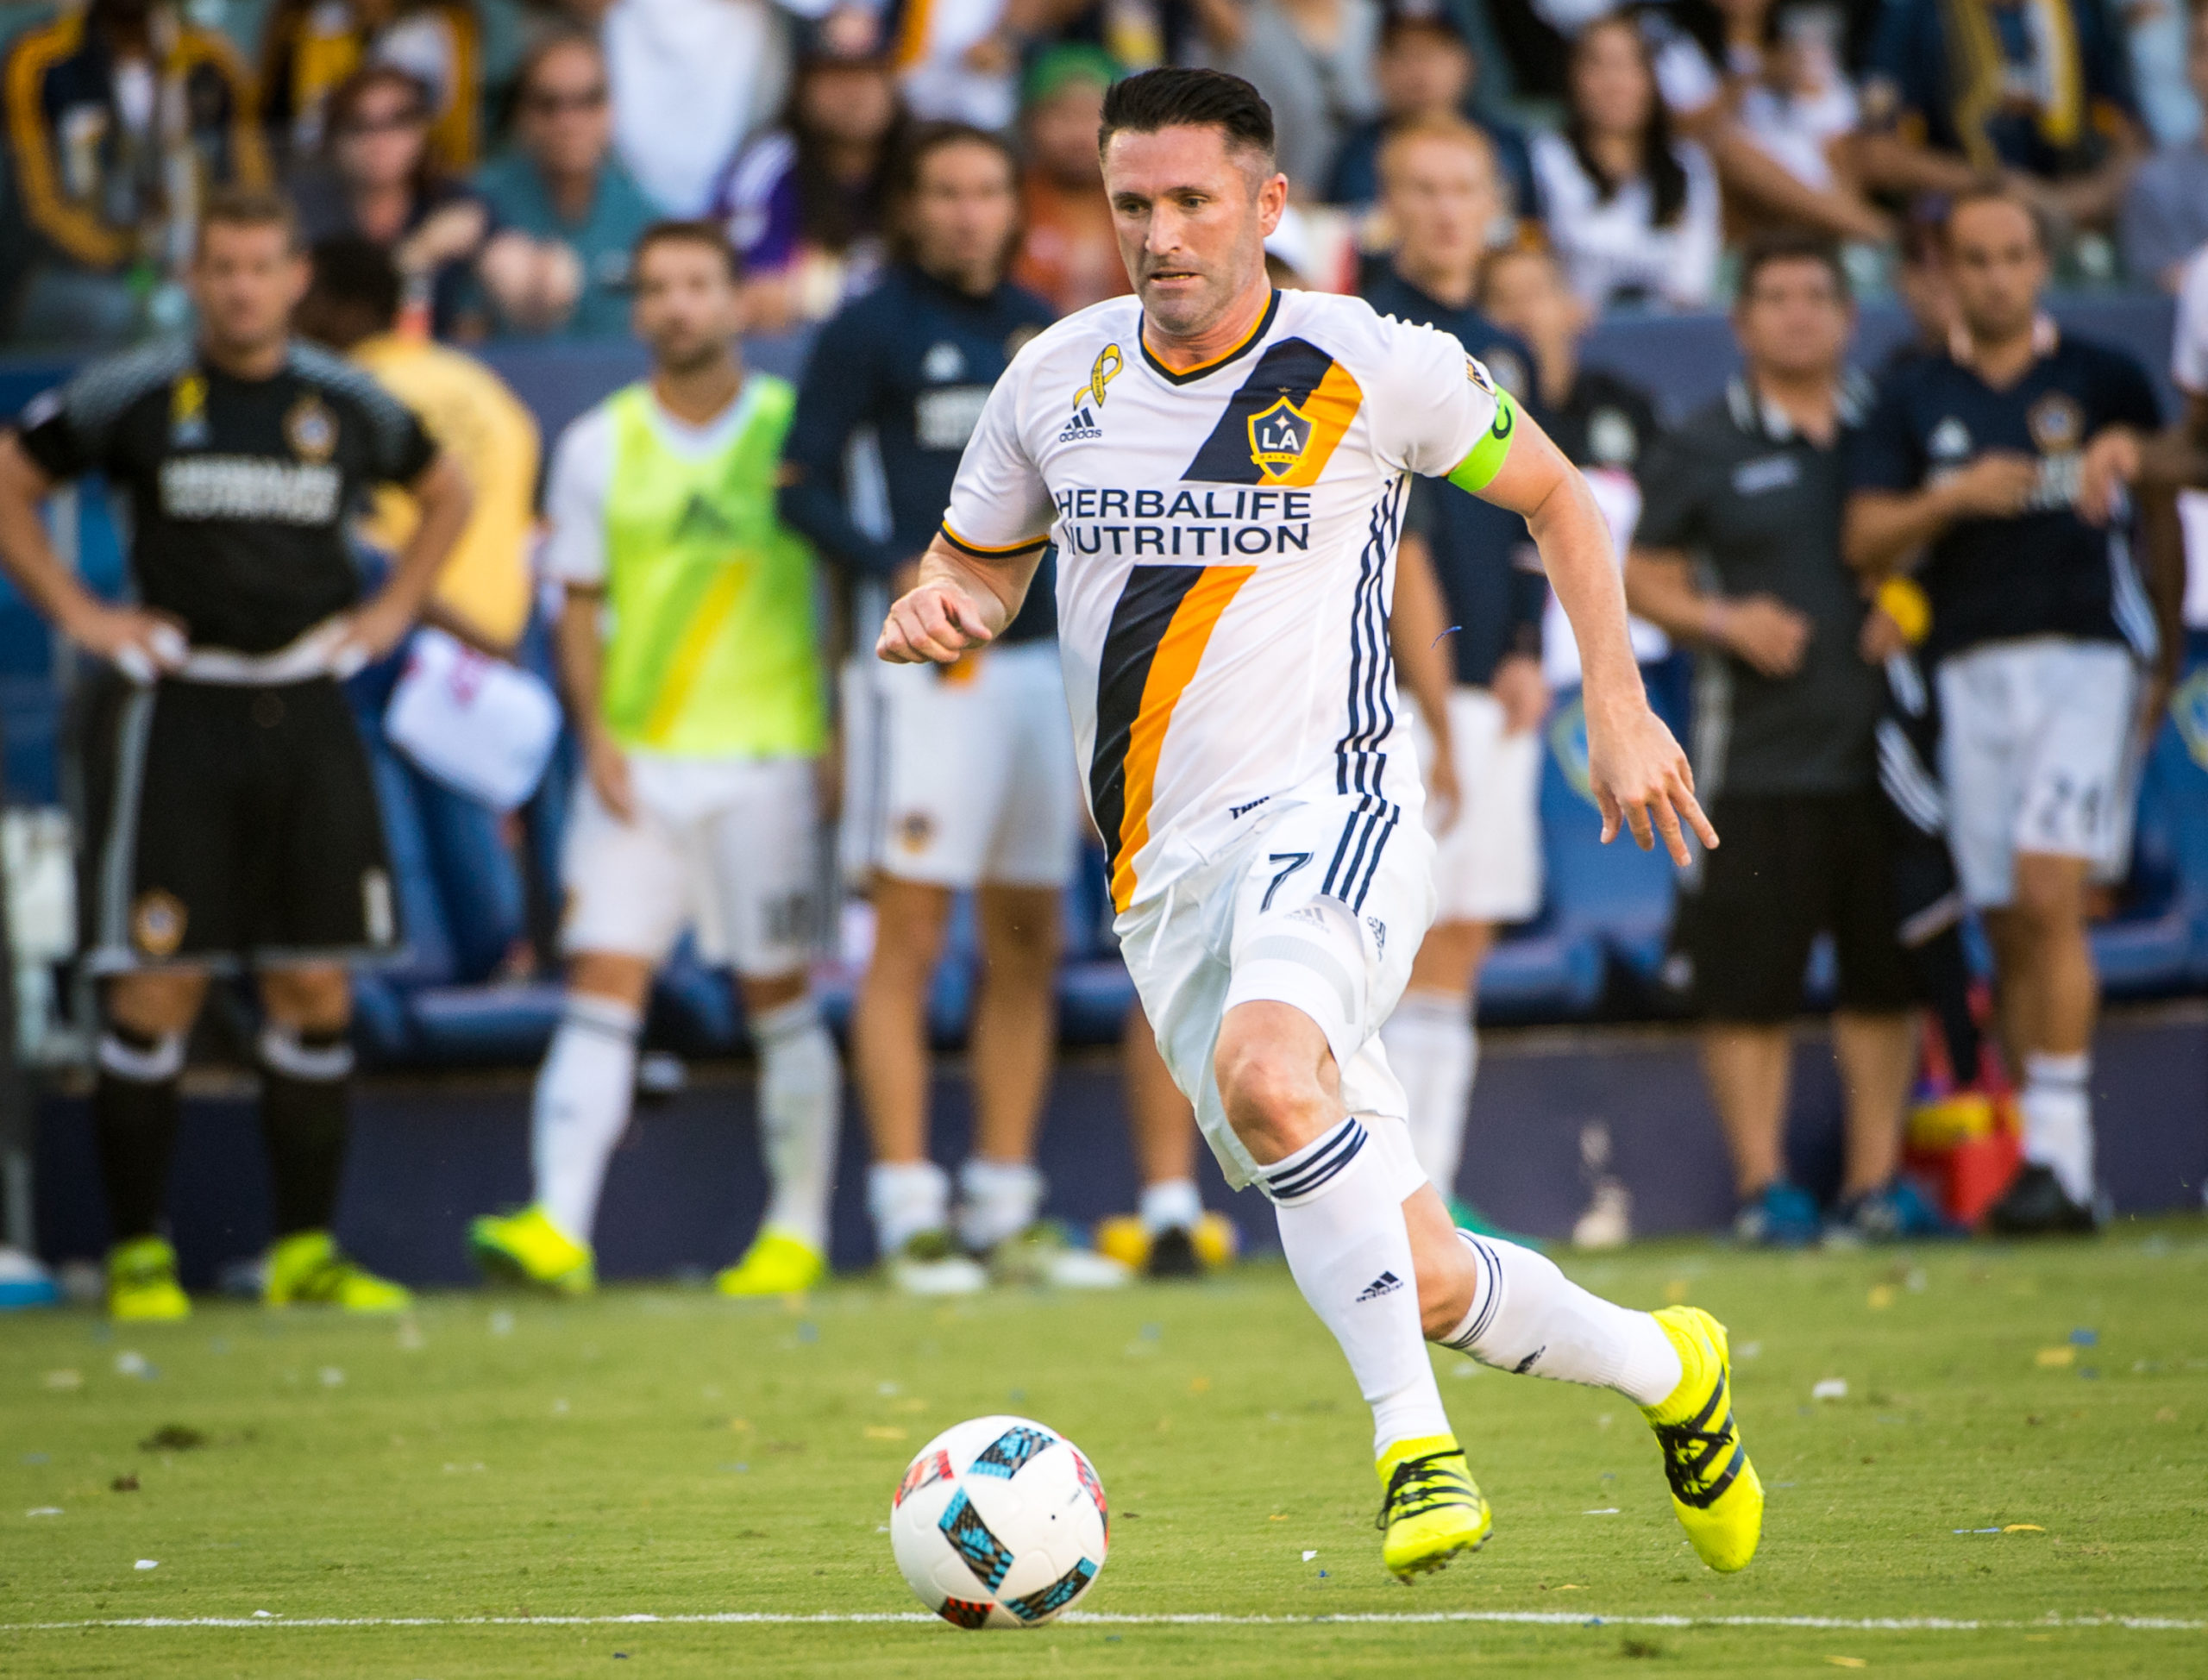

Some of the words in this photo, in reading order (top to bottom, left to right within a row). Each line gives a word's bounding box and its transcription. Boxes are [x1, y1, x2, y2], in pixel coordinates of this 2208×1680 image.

[1059, 426, 1102, 442] adidas
[1262, 428, 1300, 450] LA
[1055, 489, 1311, 520] HERBALIFE
[1062, 523, 1309, 556] NUTRITION
[1258, 851, 1314, 915] 7
